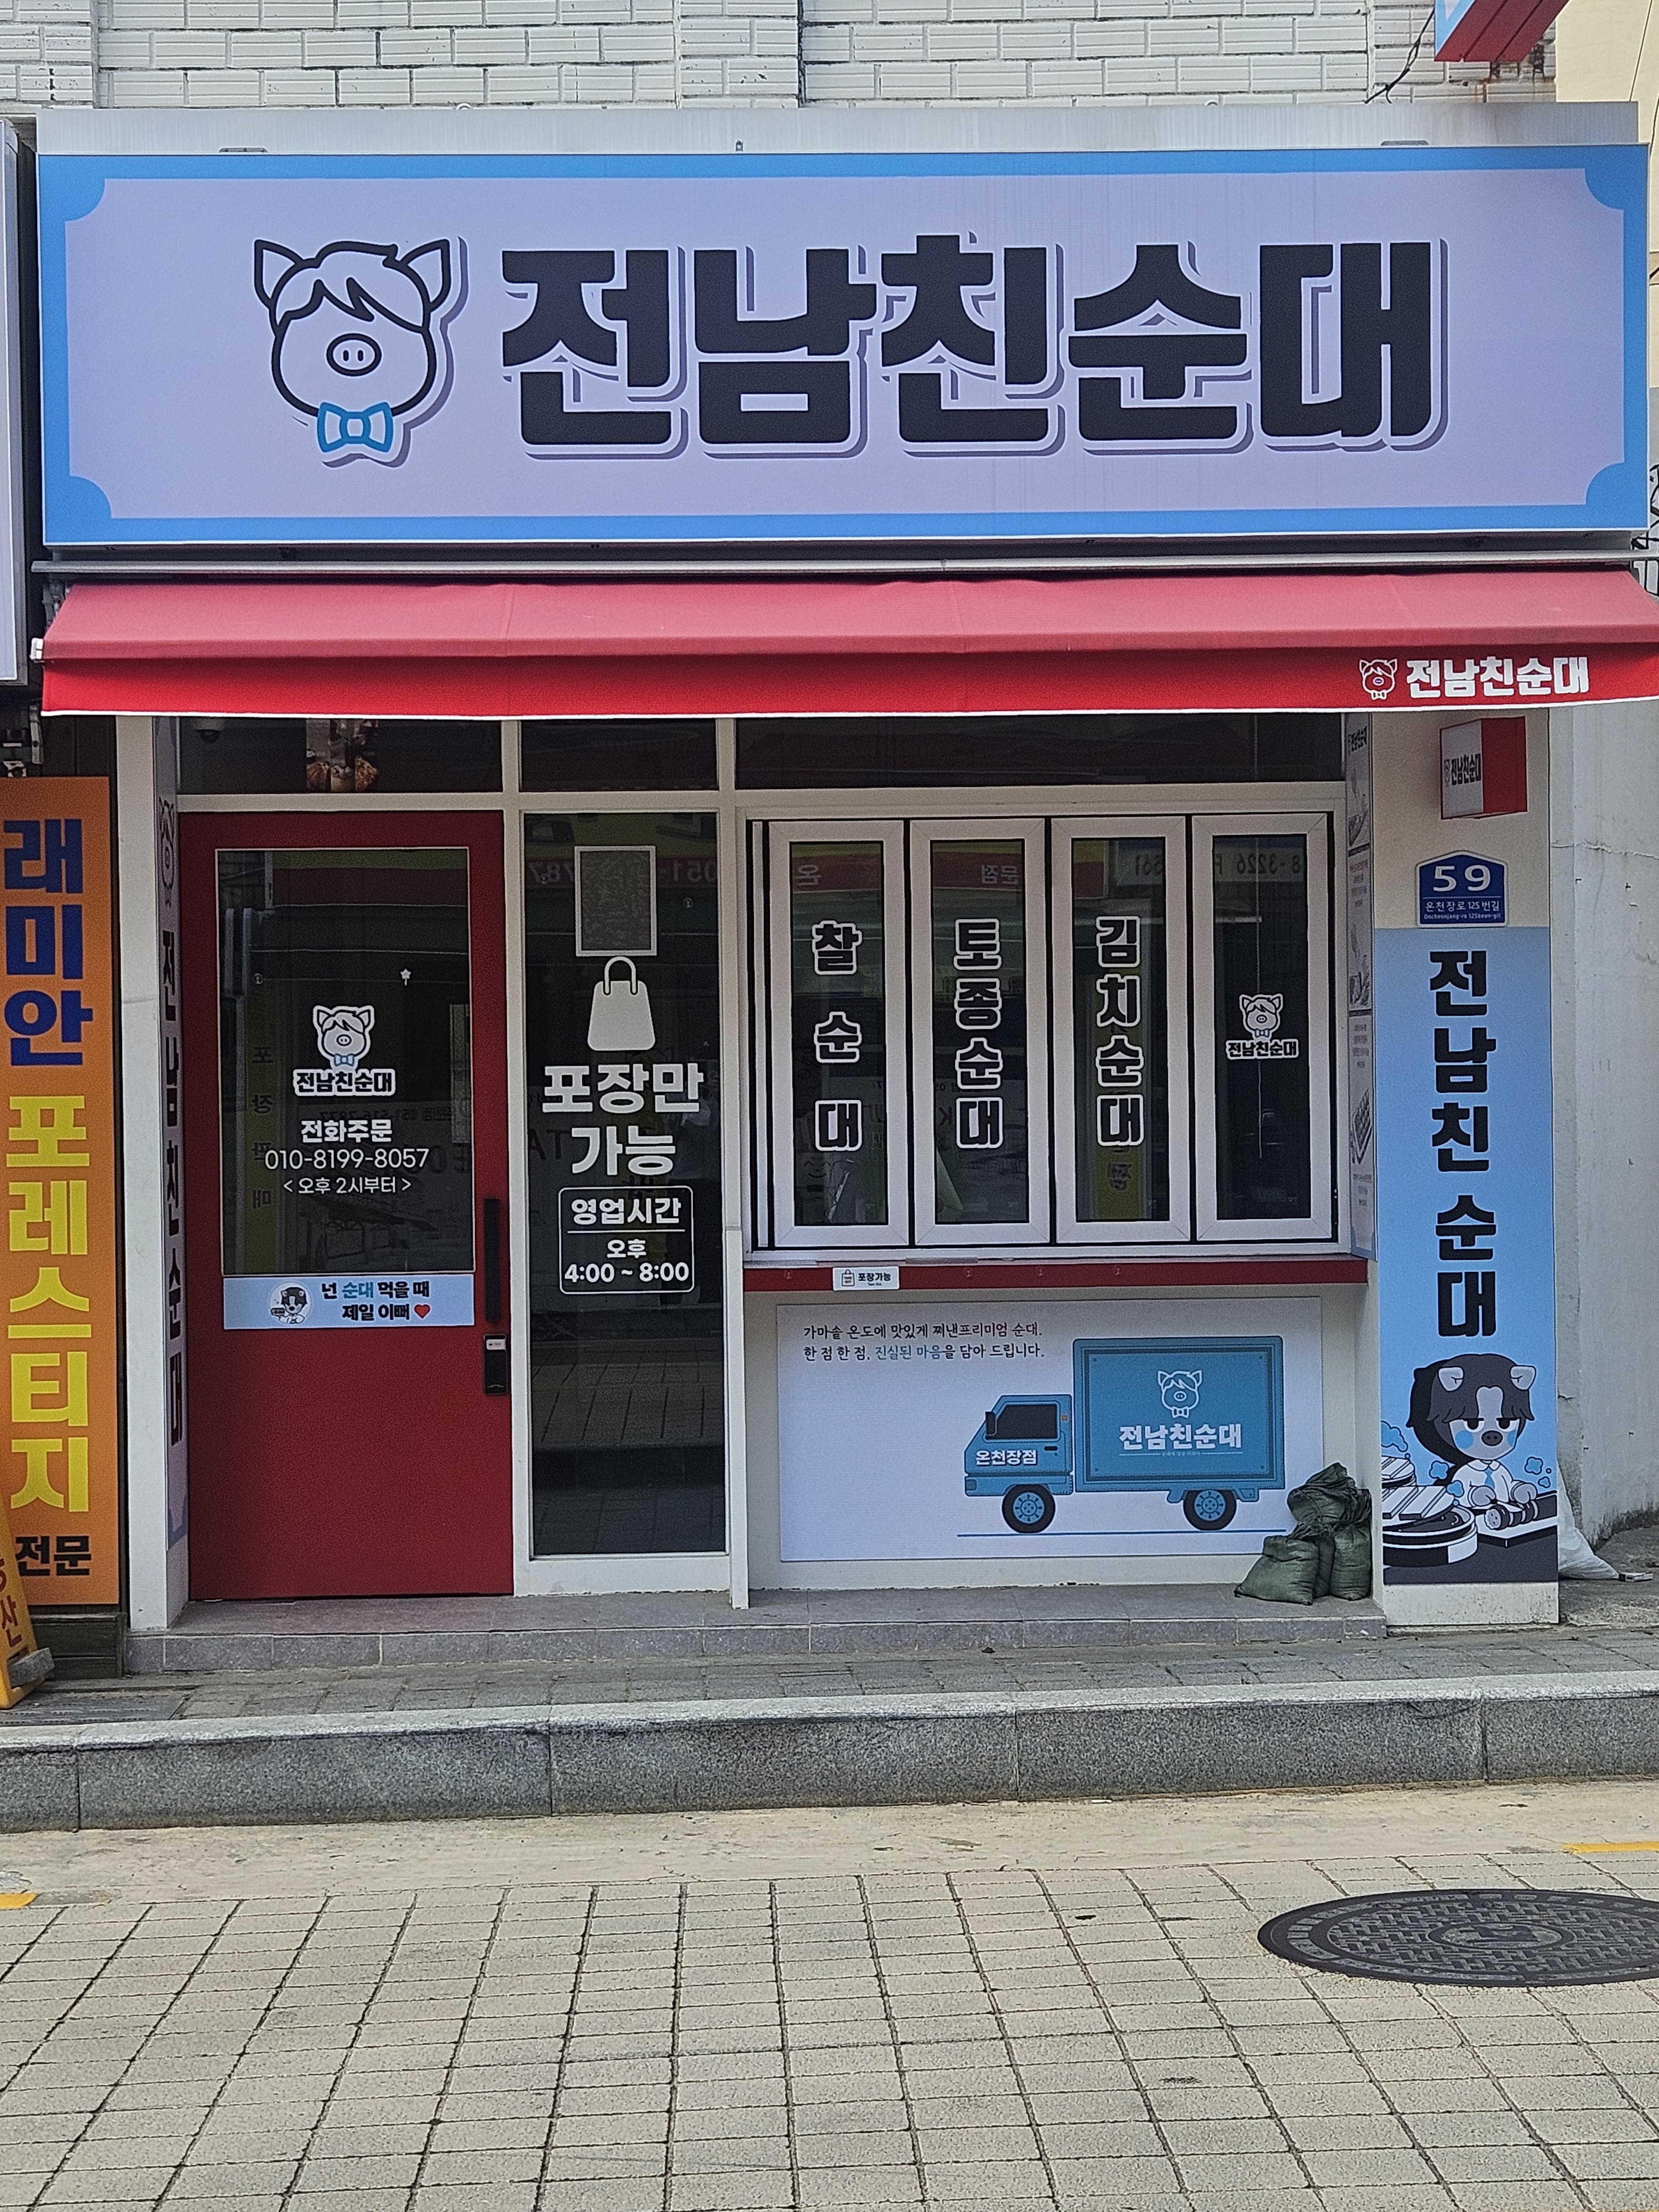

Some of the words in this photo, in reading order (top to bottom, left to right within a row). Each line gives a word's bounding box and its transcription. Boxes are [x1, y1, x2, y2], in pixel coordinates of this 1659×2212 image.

[501, 234, 1444, 458] 전남친순대
[1406, 656, 1589, 698] 전남친순대
[1451, 753, 1481, 785] 전남친순대
[1433, 864, 1491, 891] 59
[1425, 901, 1466, 912] 온천장로
[2, 818, 93, 1066] 래미안
[953, 918, 1003, 1149] 토종순대
[1095, 916, 1144, 1146] 김치순대
[1227, 1040, 1297, 1058] 전남친순대
[295, 1071, 393, 1093] 전남친순대
[542, 1063, 704, 1113] 포장만
[300, 1119, 393, 1143] 전화주문
[265, 1149, 429, 1170] 010-8199-8057
[571, 1125, 676, 1176] 가능
[298, 1178, 331, 1194] 오후
[336, 1177, 396, 1194] 2시부터
[571, 1197, 681, 1225] 영업시간
[607, 1239, 647, 1259] 오후
[564, 1264, 615, 1283] 4:00
[639, 1262, 689, 1282] 8:00
[858, 1272, 891, 1282] 포장가능
[321, 1283, 337, 1298] 넌
[342, 1282, 373, 1298] 순대
[378, 1282, 410, 1297] 먹을
[413, 1281, 430, 1297] 때
[7, 1095, 92, 1512] 포레스티지
[342, 1305, 374, 1320] 제일
[378, 1303, 410, 1319] 이뻐
[804, 1325, 843, 1339] 가마솥
[847, 1323, 886, 1339] 온도에
[891, 1323, 928, 1339] 맛있게
[1011, 1322, 1042, 1336] 순대.
[804, 1345, 817, 1361] 한
[821, 1345, 832, 1361] 점
[837, 1345, 851, 1360] 한
[875, 1344, 912, 1360] 진실된
[916, 1344, 956, 1359] 마음을
[960, 1343, 986, 1359] 담아
[989, 1343, 1045, 1358] 드립니다.
[1119, 1423, 1241, 1450] 전남친순대
[975, 1450, 1038, 1465] 온천장점
[15, 1535, 92, 1577] 전문
